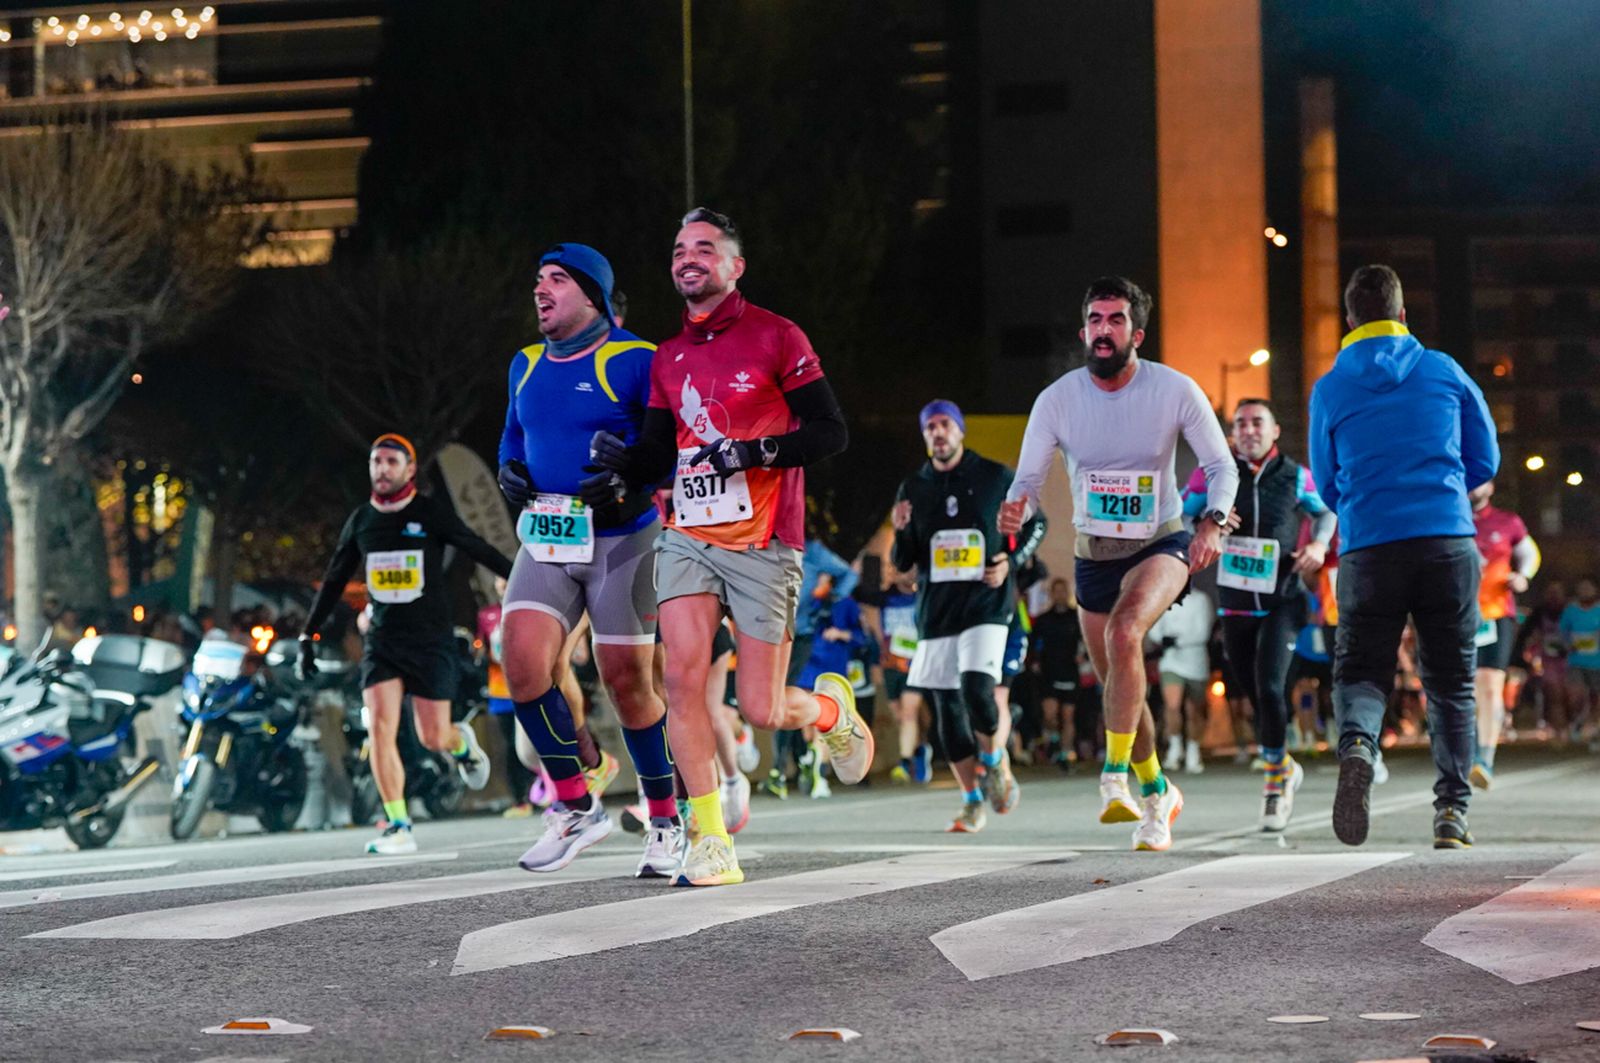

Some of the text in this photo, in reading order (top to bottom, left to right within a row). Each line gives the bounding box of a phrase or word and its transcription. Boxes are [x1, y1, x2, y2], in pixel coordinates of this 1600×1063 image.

[682, 473, 726, 499] 5377
[1100, 494, 1141, 516] 1218
[529, 514, 575, 537] 7952
[1231, 554, 1265, 574] 4578
